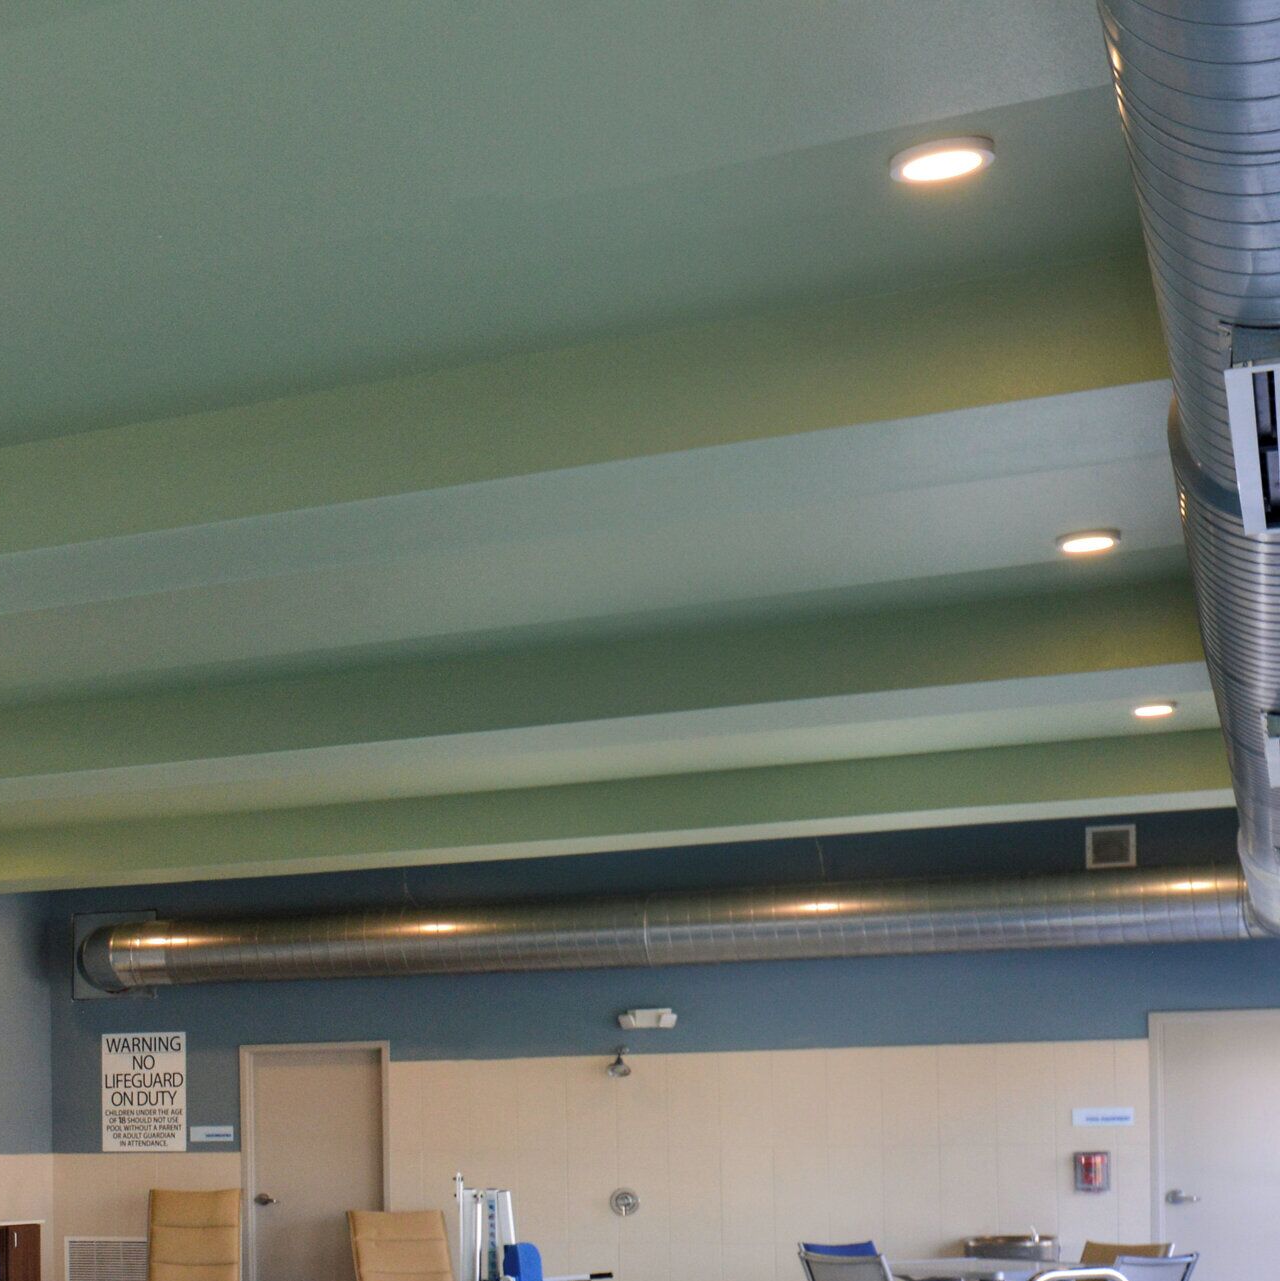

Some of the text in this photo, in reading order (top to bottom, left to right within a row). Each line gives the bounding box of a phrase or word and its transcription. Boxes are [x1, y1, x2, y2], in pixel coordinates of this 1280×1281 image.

[106, 1036, 181, 1053] WARNING
[132, 1054, 155, 1070] NO
[105, 1072, 184, 1089] LIFEGUARD
[111, 1090, 178, 1107] ON DUTY
[170, 1108, 183, 1116] AGE
